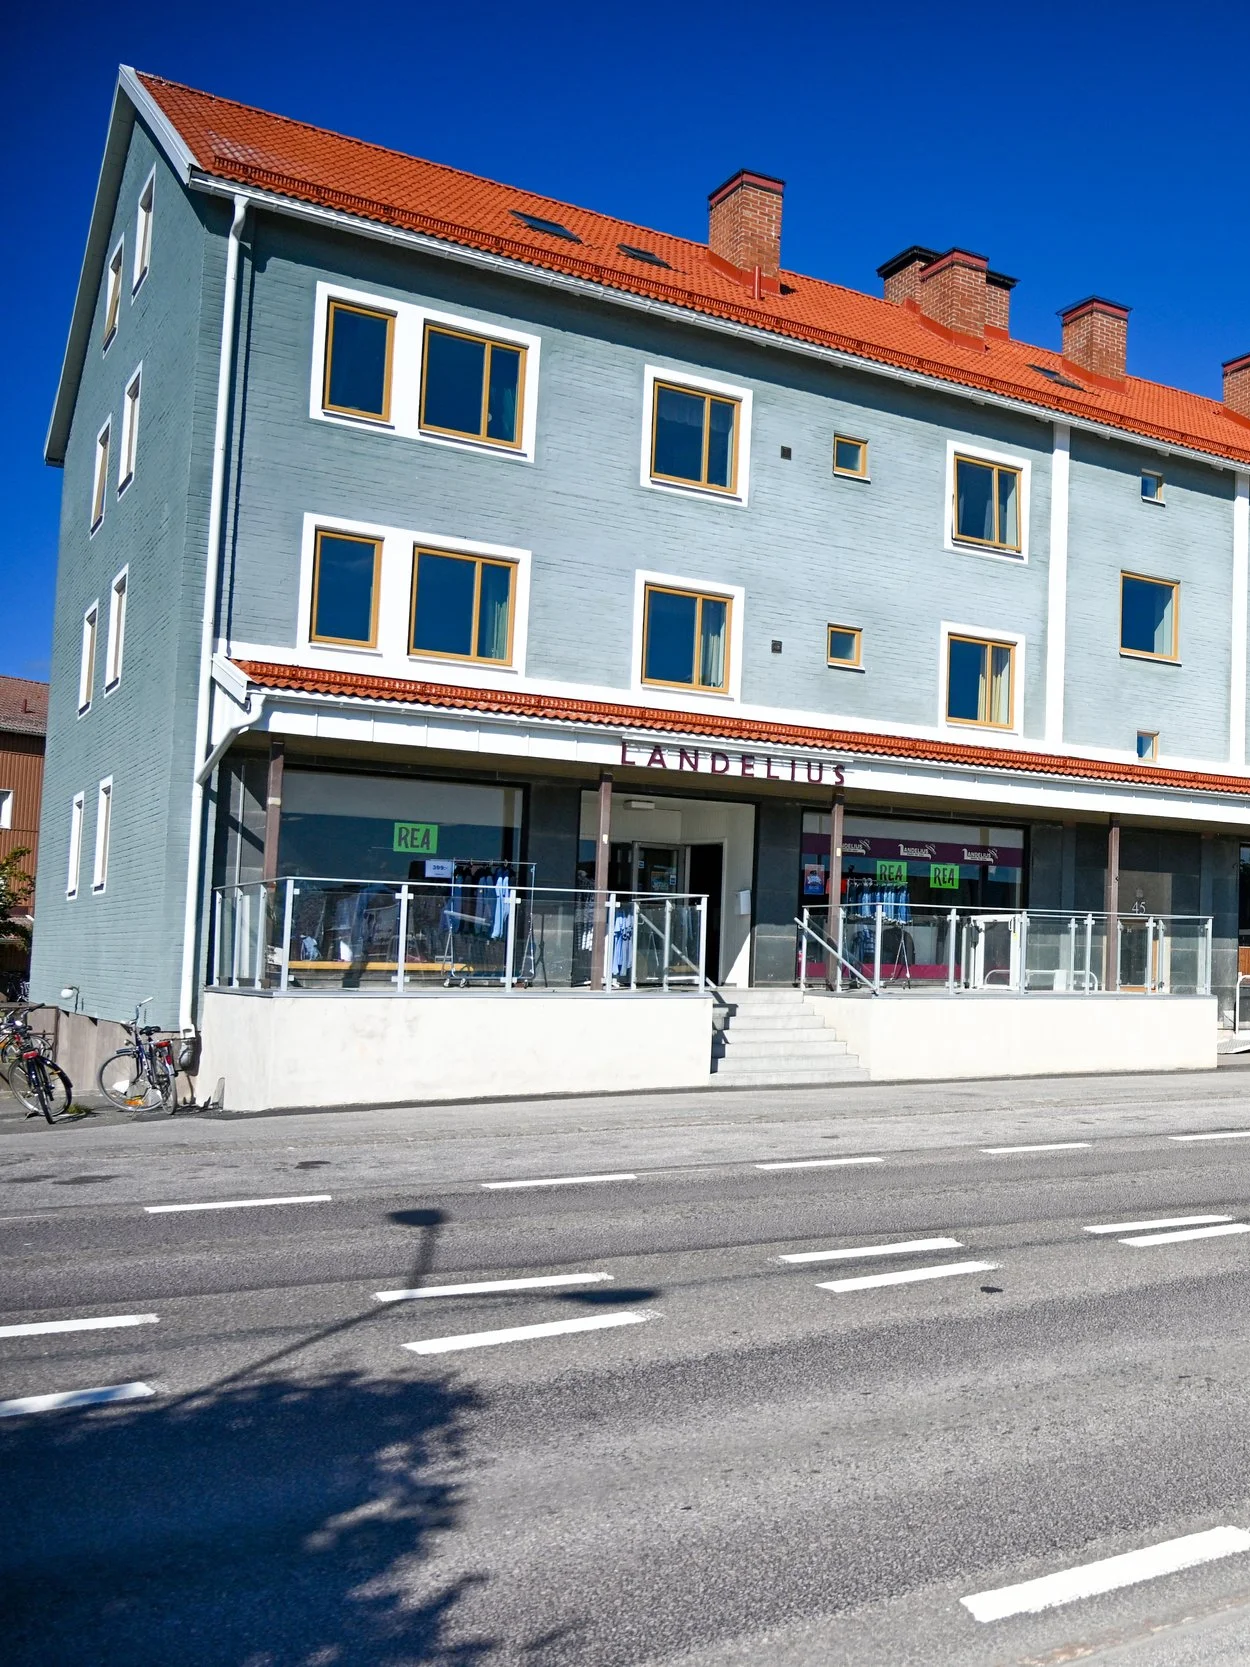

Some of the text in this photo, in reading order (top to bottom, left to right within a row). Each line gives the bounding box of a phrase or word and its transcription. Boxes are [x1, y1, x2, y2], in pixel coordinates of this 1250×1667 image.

[620, 741, 845, 785] LANDELIUS
[398, 827, 430, 850] REA
[880, 864, 903, 882] REA
[934, 866, 955, 886] REA
[1131, 901, 1146, 914] 45
